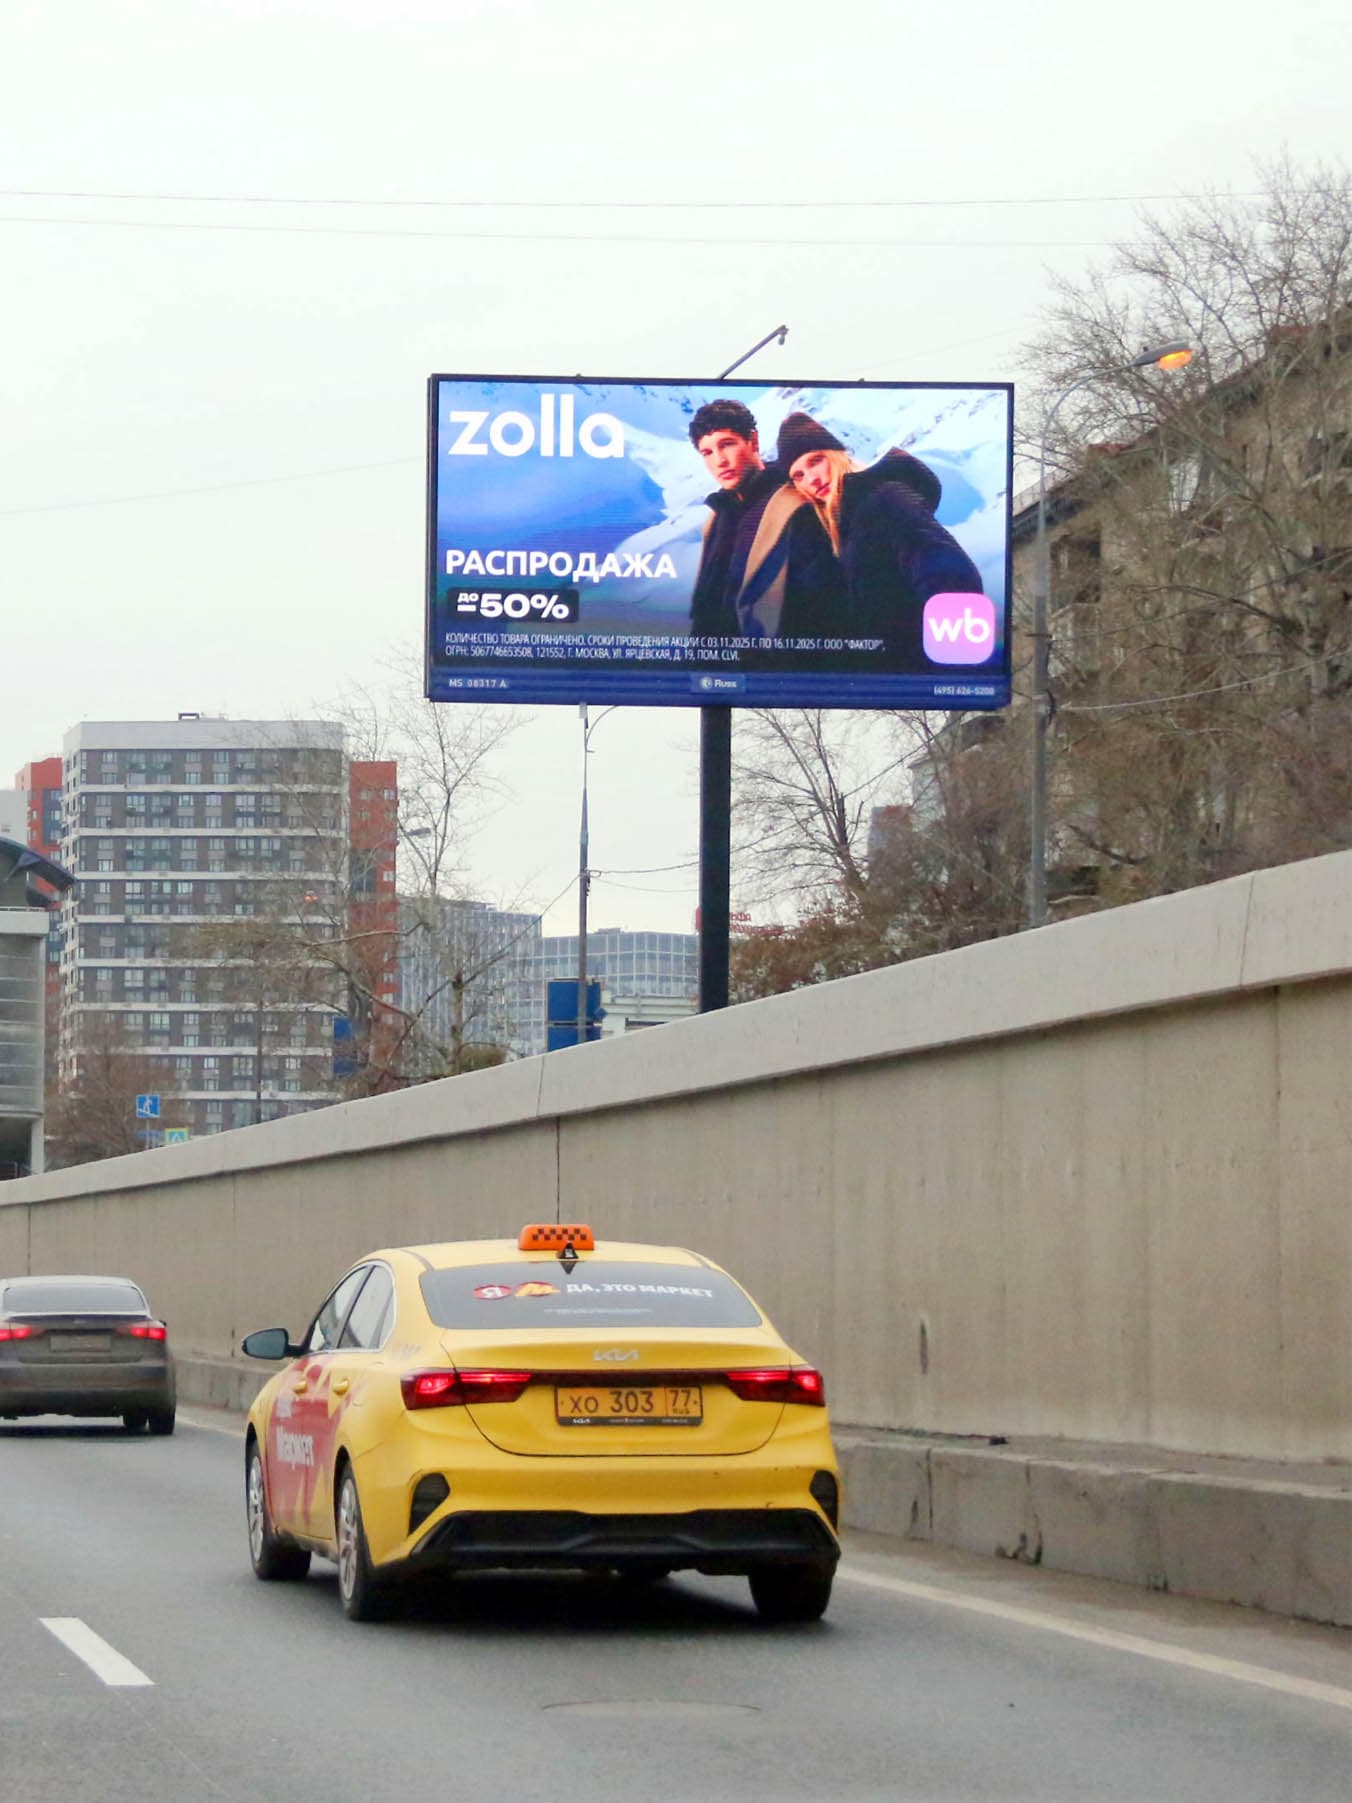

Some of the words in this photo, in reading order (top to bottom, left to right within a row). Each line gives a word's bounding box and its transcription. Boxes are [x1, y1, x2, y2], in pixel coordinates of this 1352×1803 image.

[448, 393, 625, 459] zolla
[446, 550, 677, 582] РАСПРОДАЖА
[929, 607, 990, 643] wb
[445, 632, 498, 644] КОЛИЧЕСТВО
[500, 633, 529, 645] ТОВАРА
[530, 634, 586, 646] ОГРАНИЧЕНО.
[588, 635, 615, 647] СРОКИ
[616, 635, 669, 648] ПРОВЕДЕНИЯ
[670, 636, 699, 648] АКЦИИ
[700, 637, 707, 647] С
[759, 638, 772, 648] ПО
[774, 638, 816, 649] 16.11.2025
[824, 639, 843, 649] ООО
[639, 1284, 713, 1298] МАРКЕТ
[609, 1390, 654, 1413] 303
[669, 1389, 691, 1407] 77
